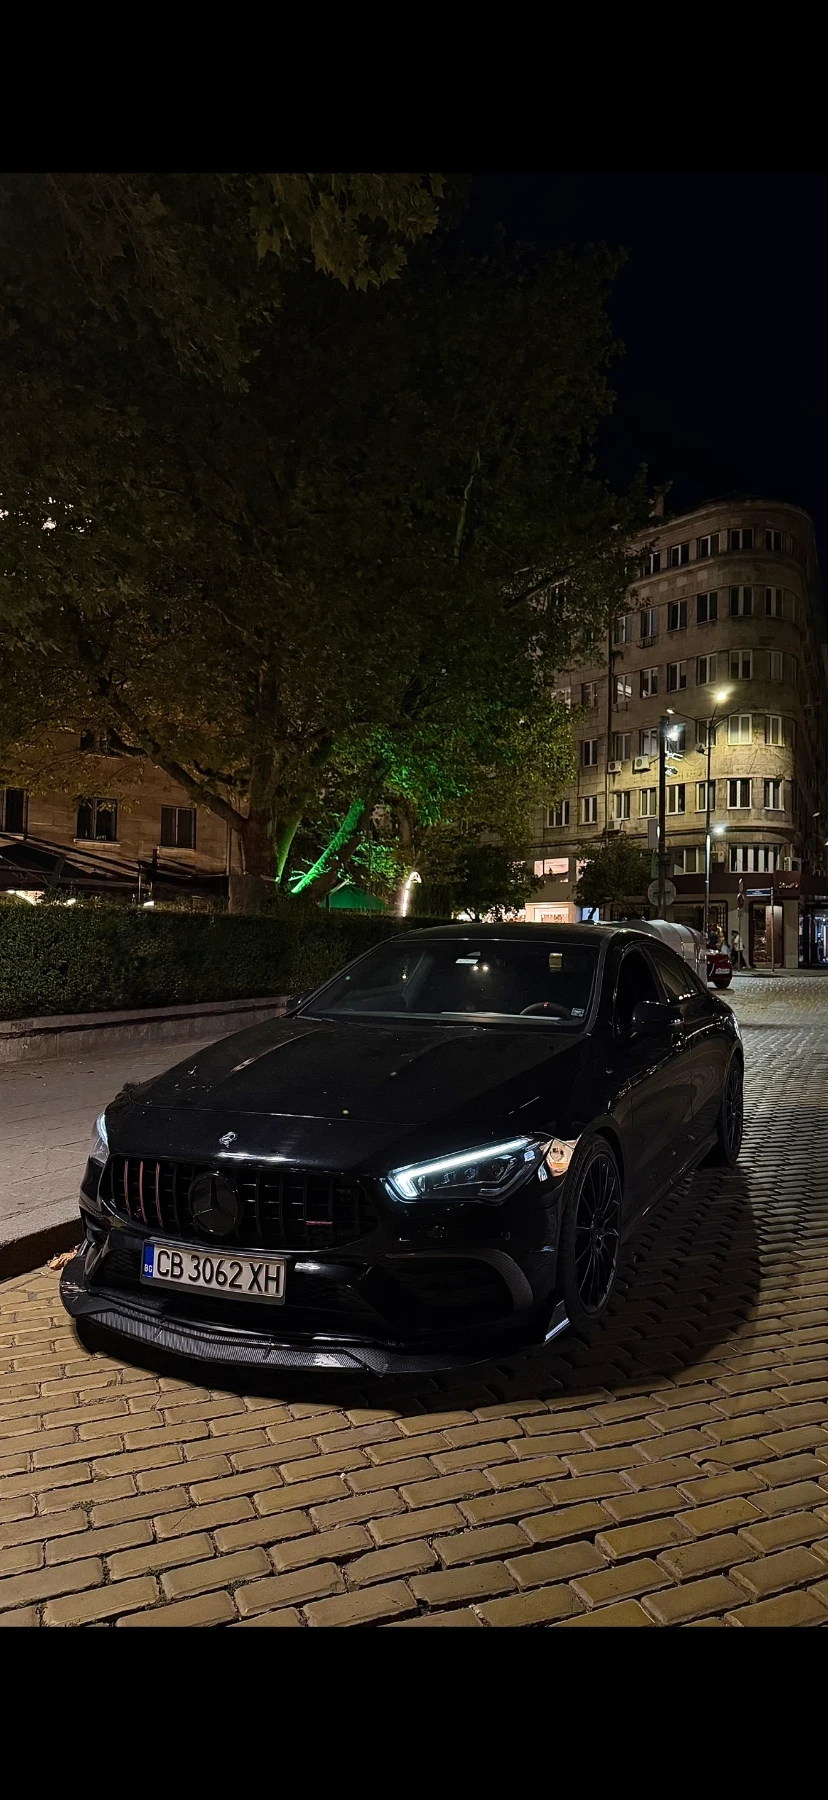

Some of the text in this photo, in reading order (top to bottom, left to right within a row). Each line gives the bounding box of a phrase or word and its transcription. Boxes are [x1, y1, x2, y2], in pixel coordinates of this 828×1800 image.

[144, 1263, 153, 1273] BG
[157, 1249, 282, 1294] CB 3062 XH
